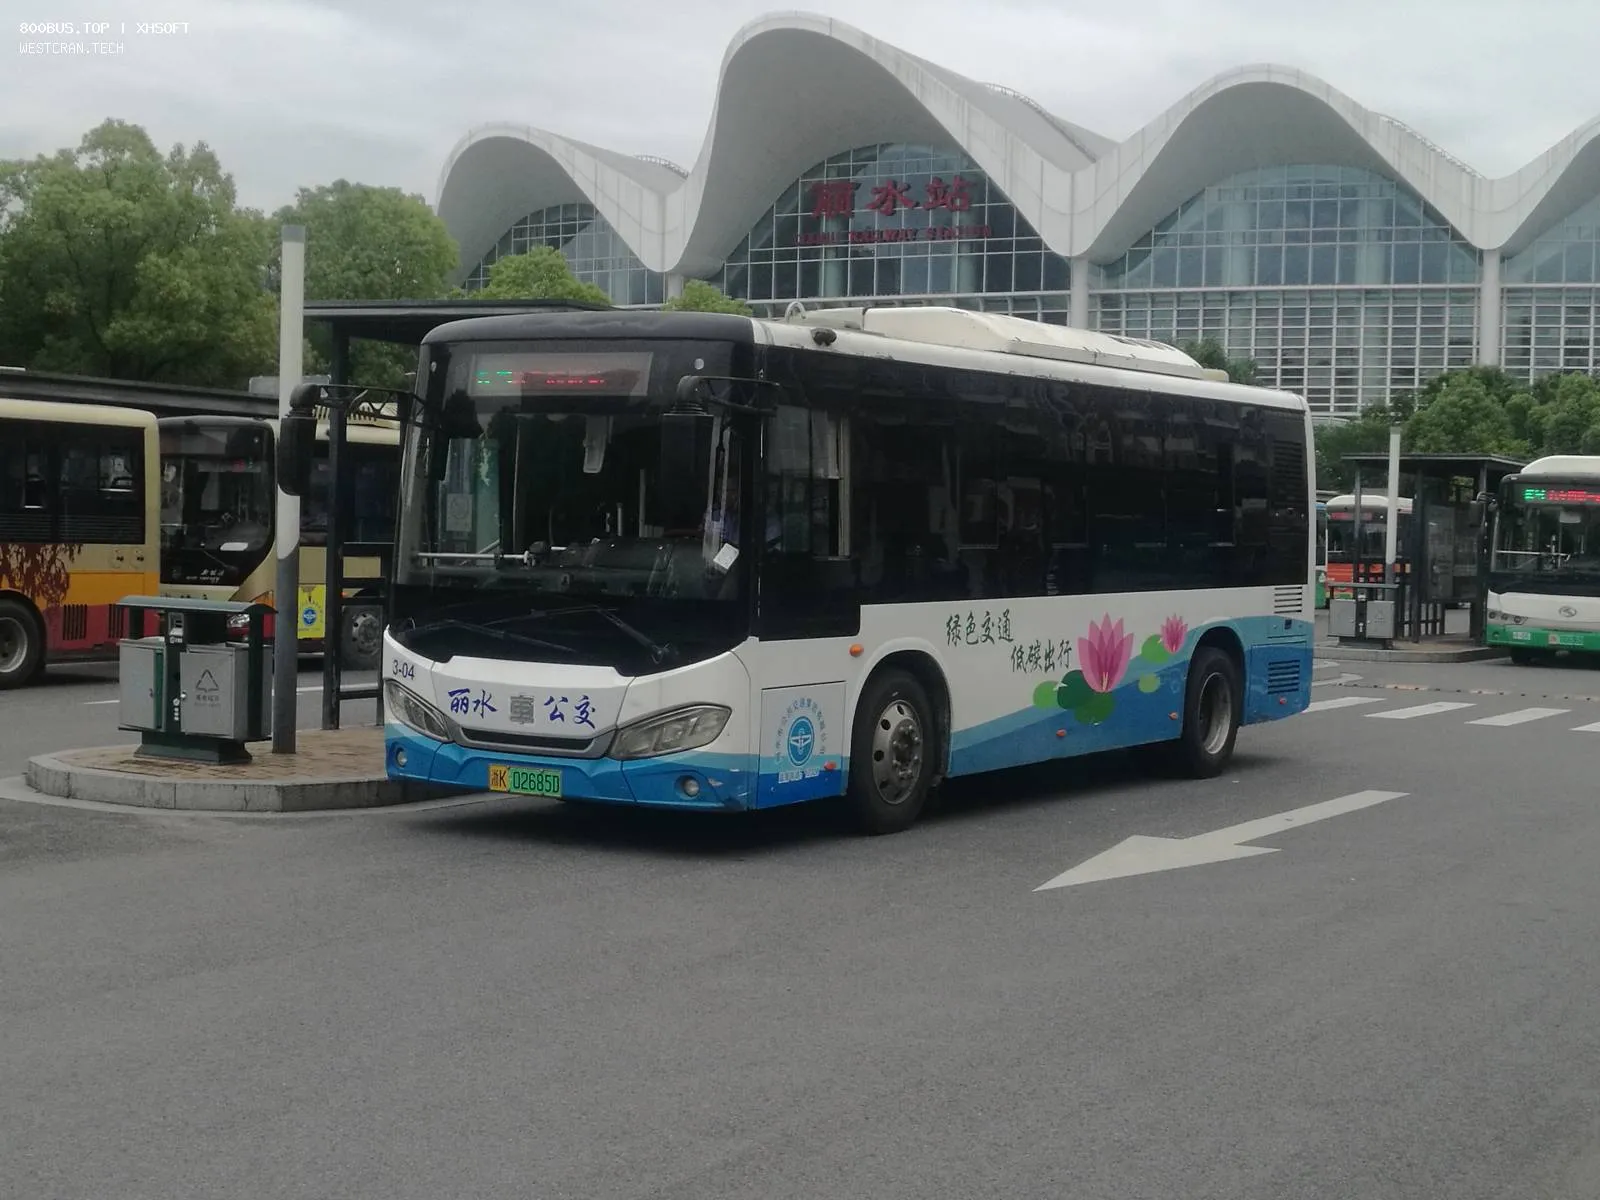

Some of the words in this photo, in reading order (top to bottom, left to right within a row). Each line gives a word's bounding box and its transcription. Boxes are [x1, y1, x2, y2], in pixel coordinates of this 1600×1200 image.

[811, 175, 976, 220] 丽水站
[946, 608, 1014, 647] 绿色交通
[392, 660, 416, 681] 3-04
[1010, 639, 1072, 673] 低碳出行
[447, 688, 497, 718] 丽水
[543, 694, 596, 729] 公交
